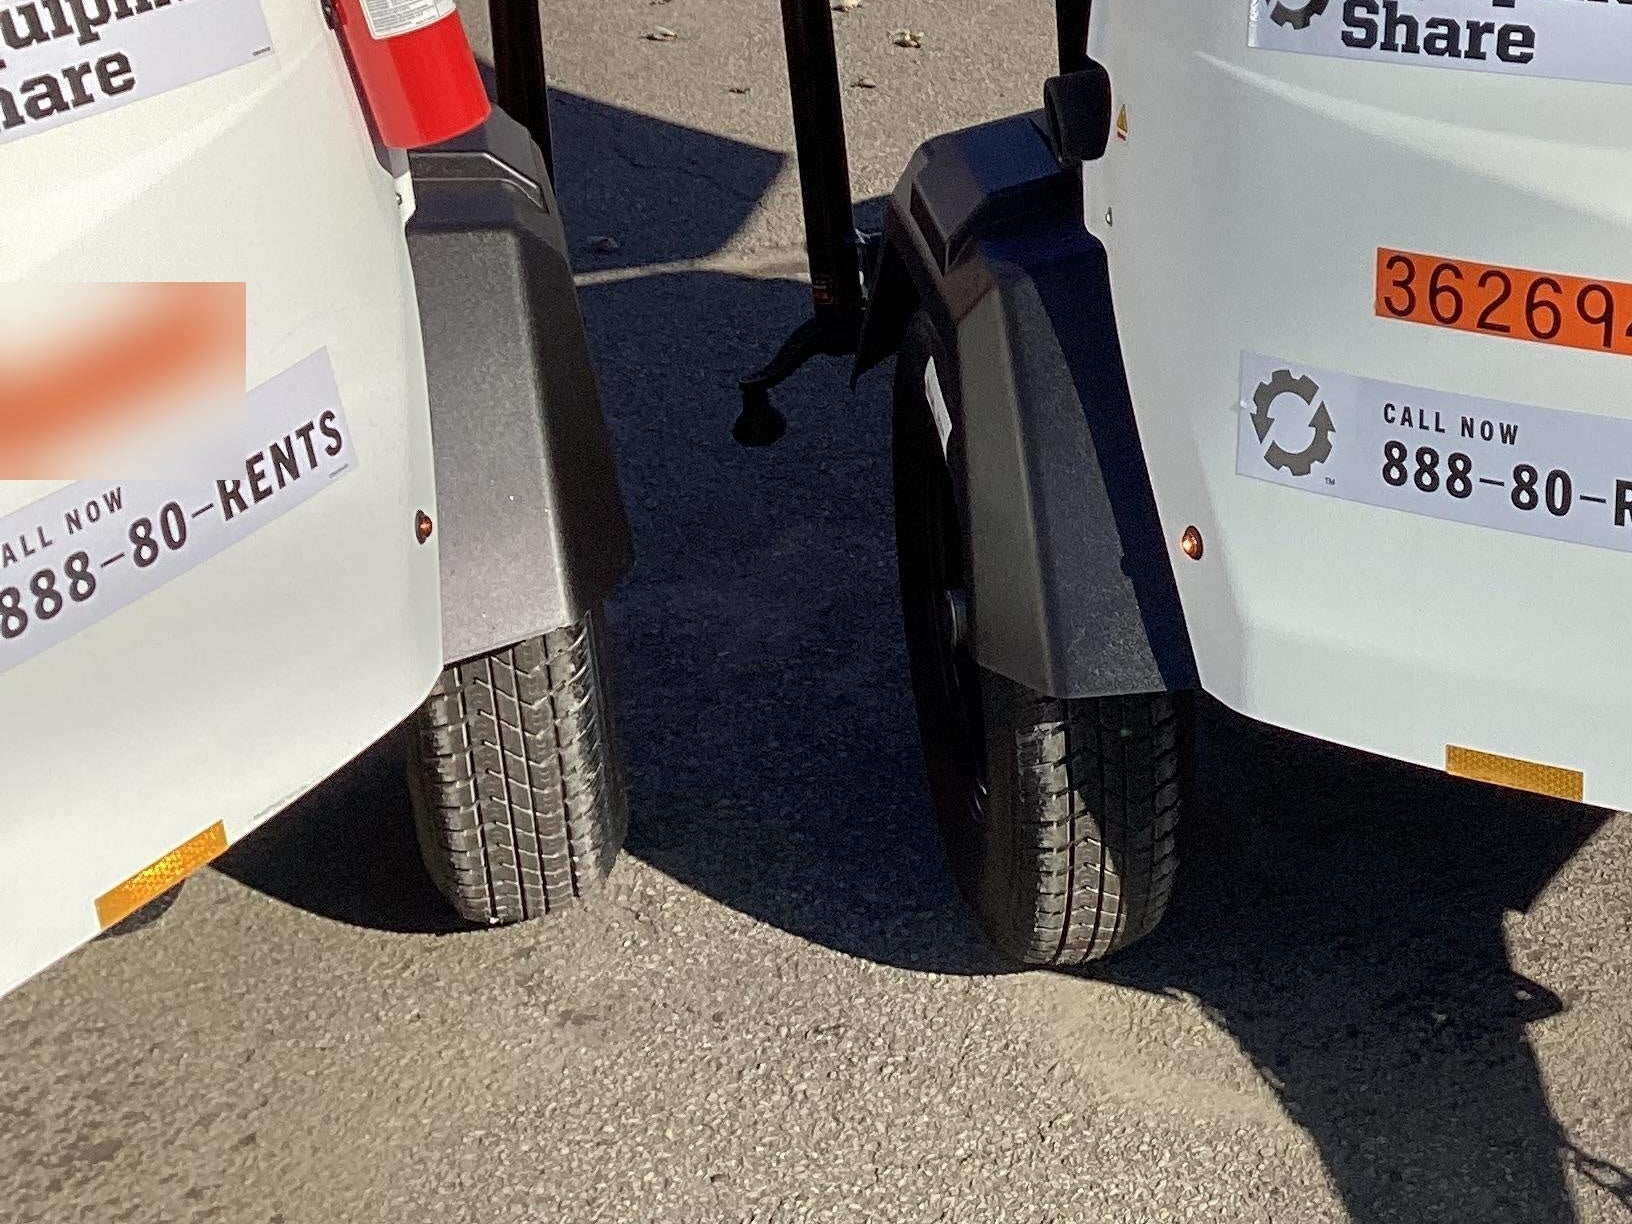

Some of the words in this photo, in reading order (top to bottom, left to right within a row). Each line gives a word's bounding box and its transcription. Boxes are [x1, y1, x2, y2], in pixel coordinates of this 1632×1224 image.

[1383, 401, 1446, 434] CALL
[1460, 415, 1520, 446] NOW
[0, 409, 343, 640] 888-80-RENTS
[64, 486, 123, 535] NOW
[0, 526, 54, 569] ALL
